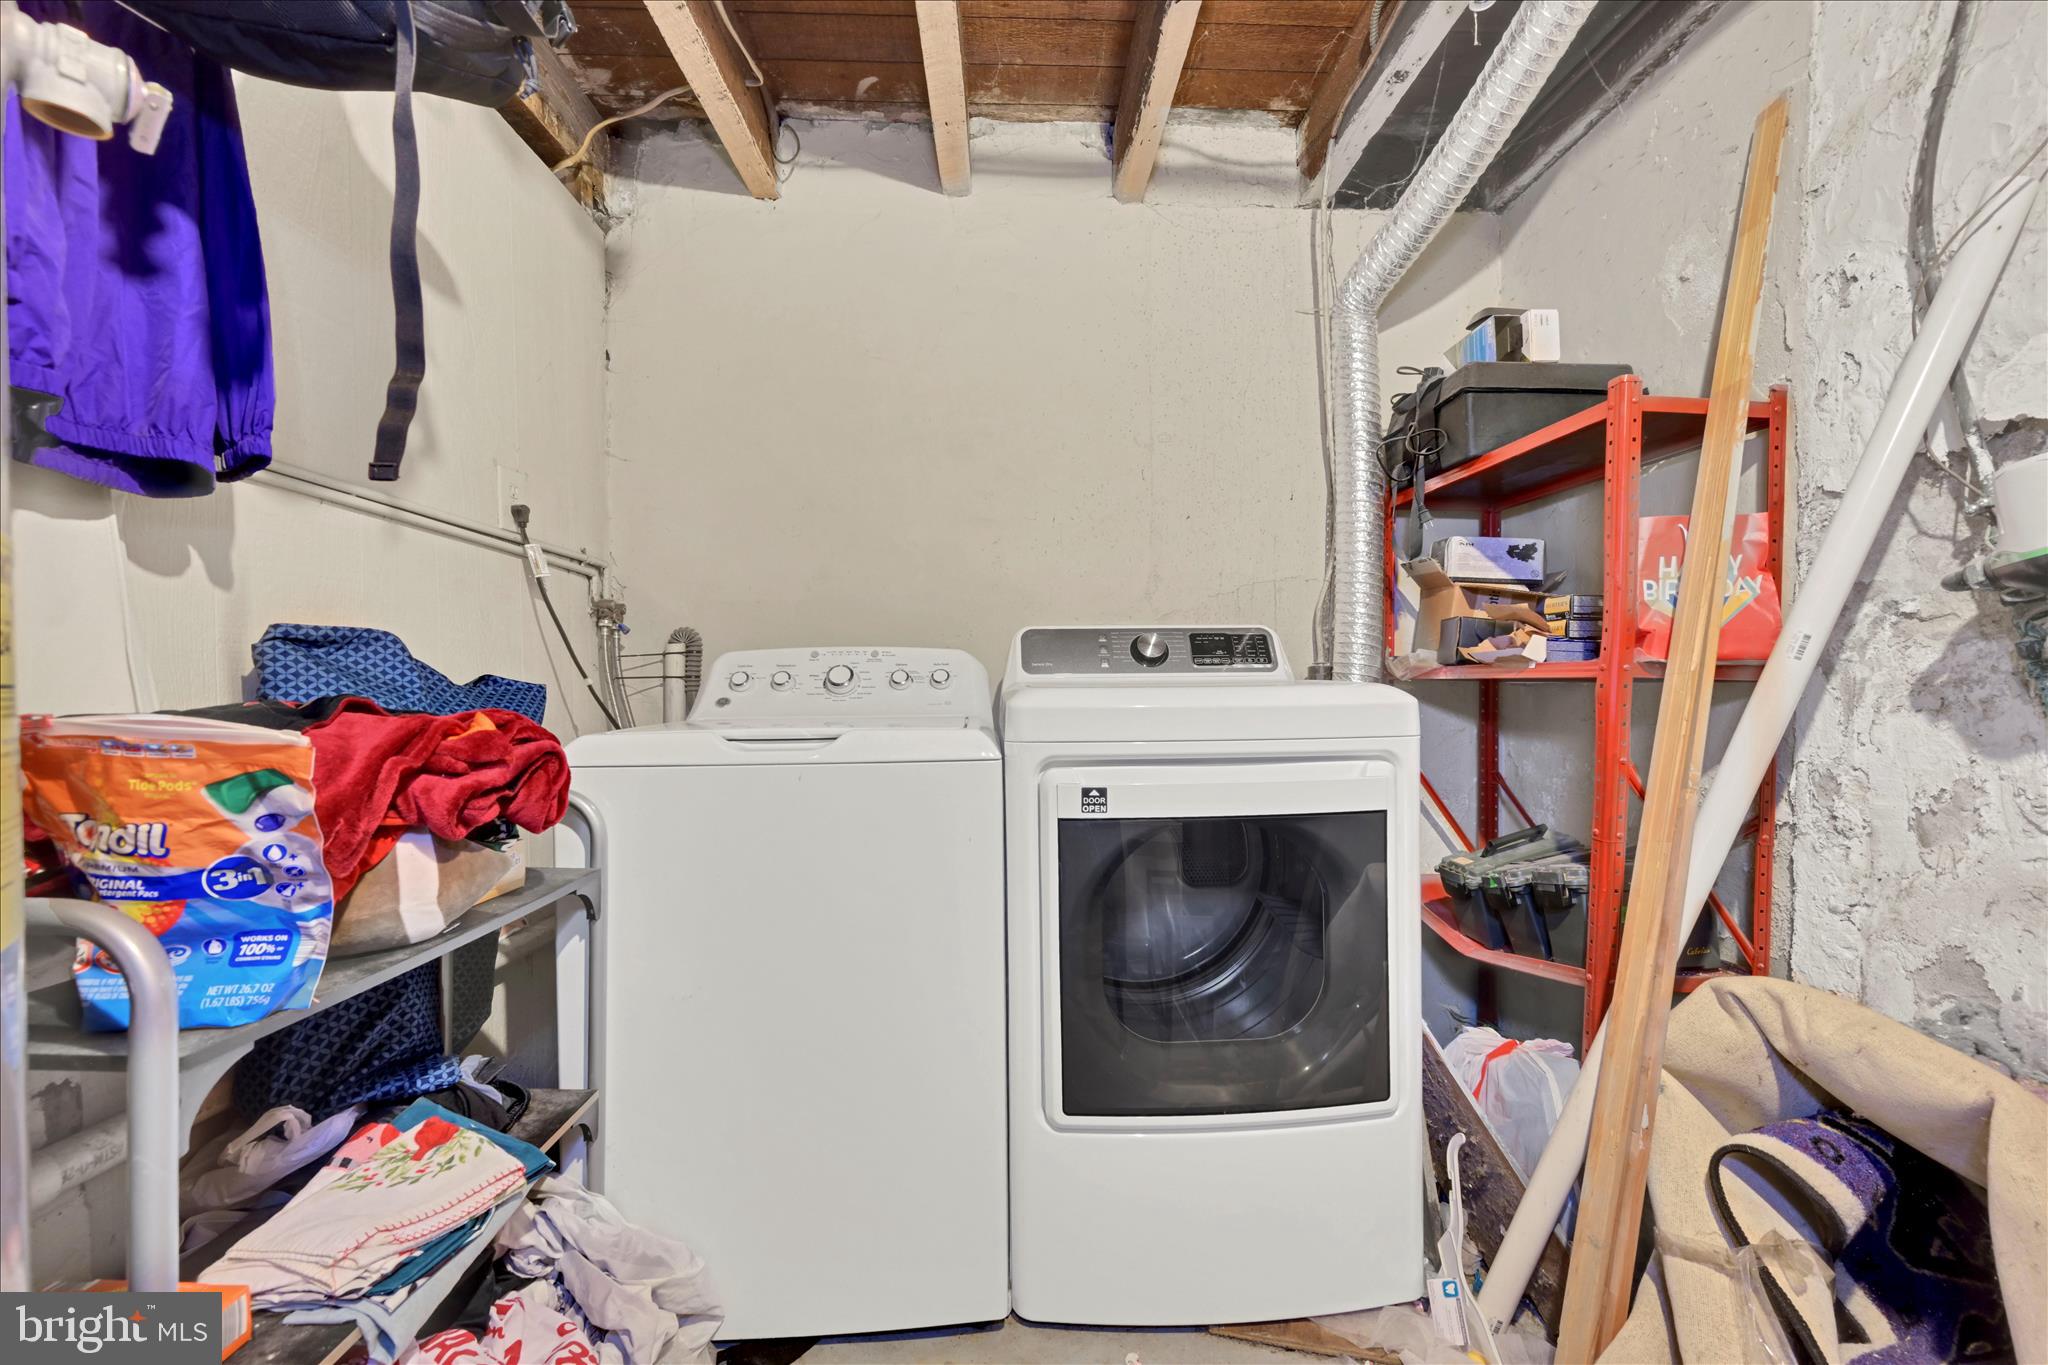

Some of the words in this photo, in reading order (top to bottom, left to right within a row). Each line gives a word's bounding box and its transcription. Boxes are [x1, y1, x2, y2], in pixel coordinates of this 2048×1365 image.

[1643, 575, 1764, 604] BIRDAY
[1082, 805, 1107, 813] OPEN
[91, 878, 146, 891] IGINAL
[99, 889, 136, 898] tergent
[240, 935, 273, 943] WORKS
[239, 942, 276, 956] 100%
[206, 985, 225, 996] NET
[224, 984, 239, 995] WT
[239, 983, 260, 994] 26.7
[261, 983, 276, 993] OZ
